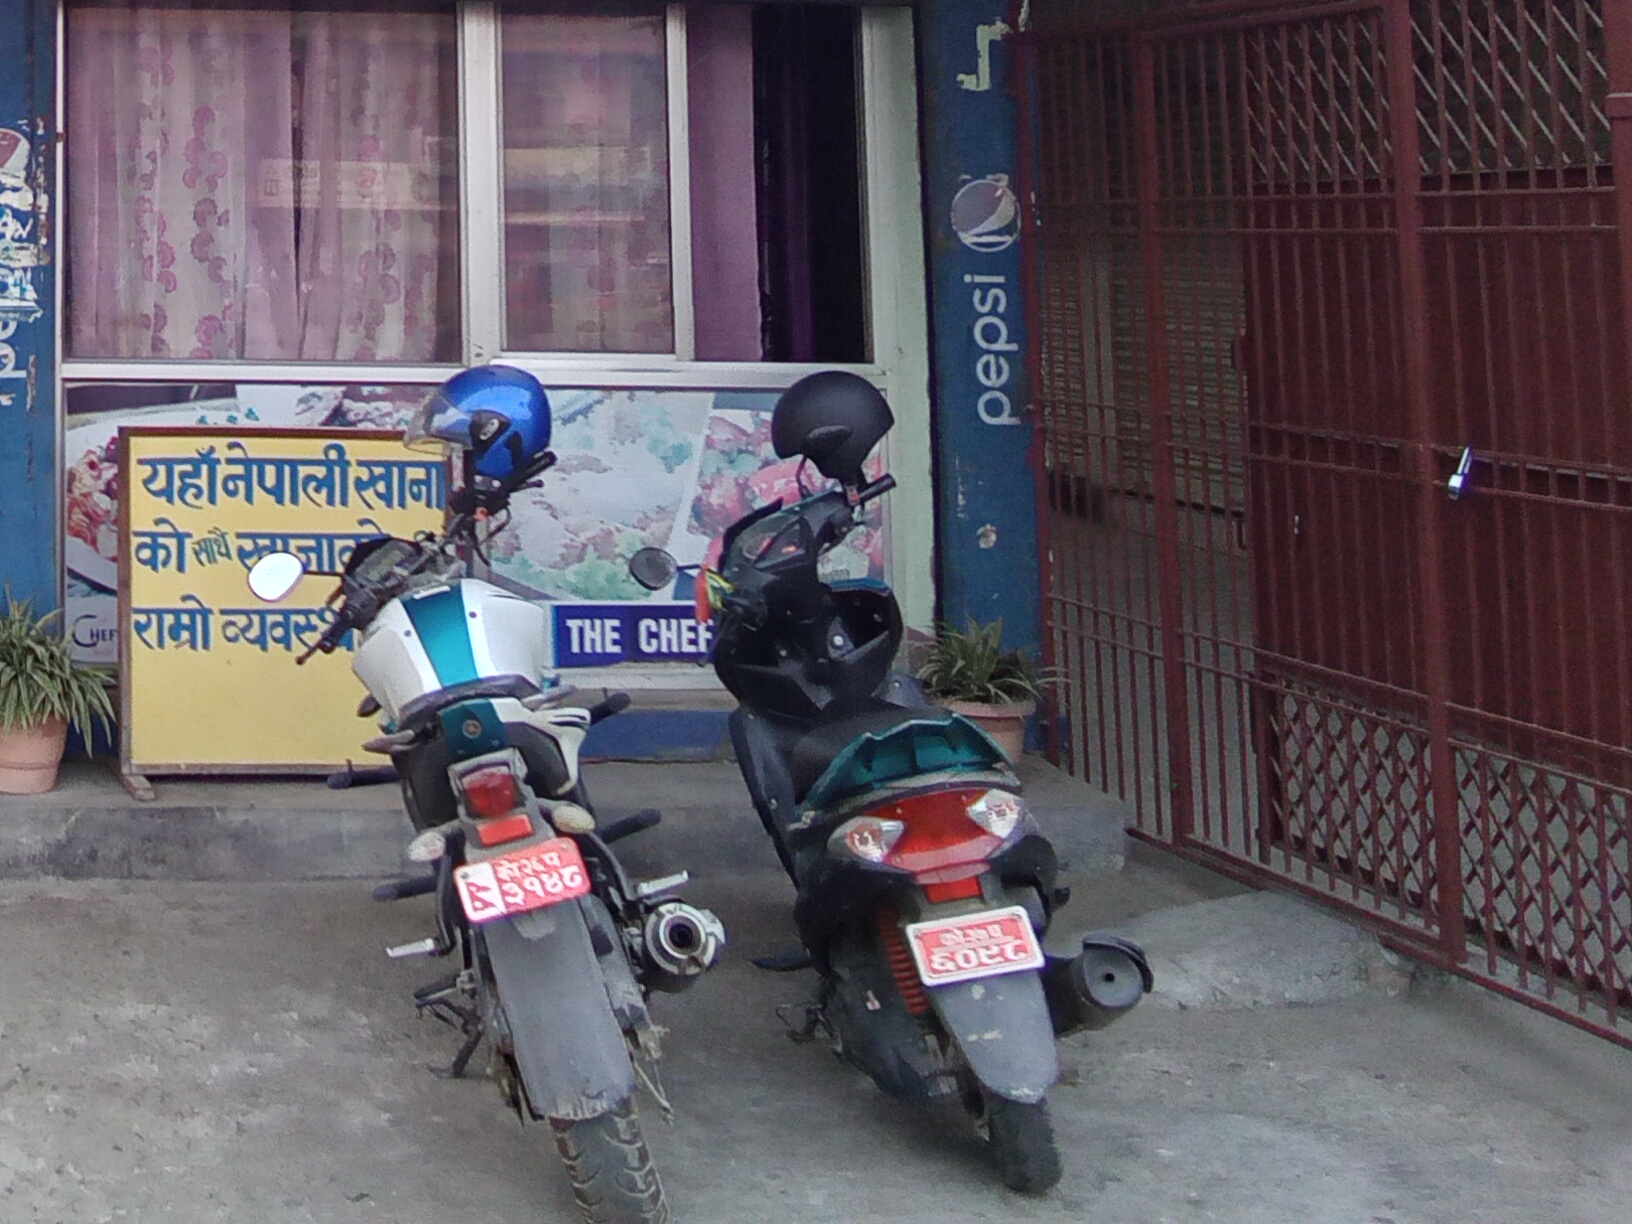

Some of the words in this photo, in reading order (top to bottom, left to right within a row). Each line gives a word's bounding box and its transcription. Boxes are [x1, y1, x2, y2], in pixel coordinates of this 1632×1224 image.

[963, 273, 1021, 426] pepsi
[223, 440, 352, 509] नेपाली
[354, 458, 446, 510] खाना
[133, 517, 193, 574] को
[565, 618, 622, 654] THE
